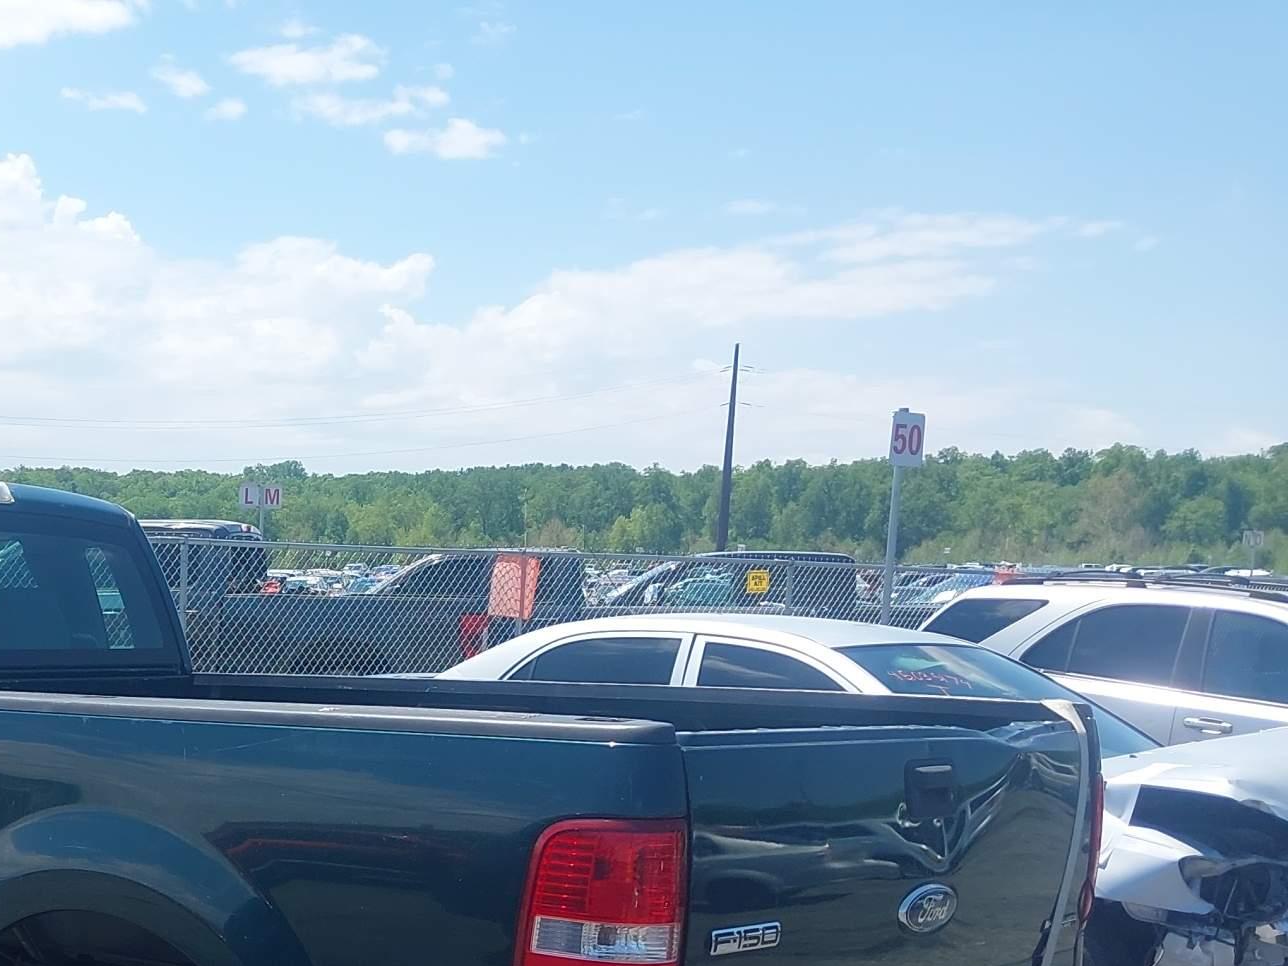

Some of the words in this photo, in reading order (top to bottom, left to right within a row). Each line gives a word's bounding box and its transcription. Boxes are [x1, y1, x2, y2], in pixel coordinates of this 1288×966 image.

[893, 424, 922, 455] 50
[244, 487, 253, 504] L
[265, 488, 280, 505] M
[918, 894, 949, 923] Ford
